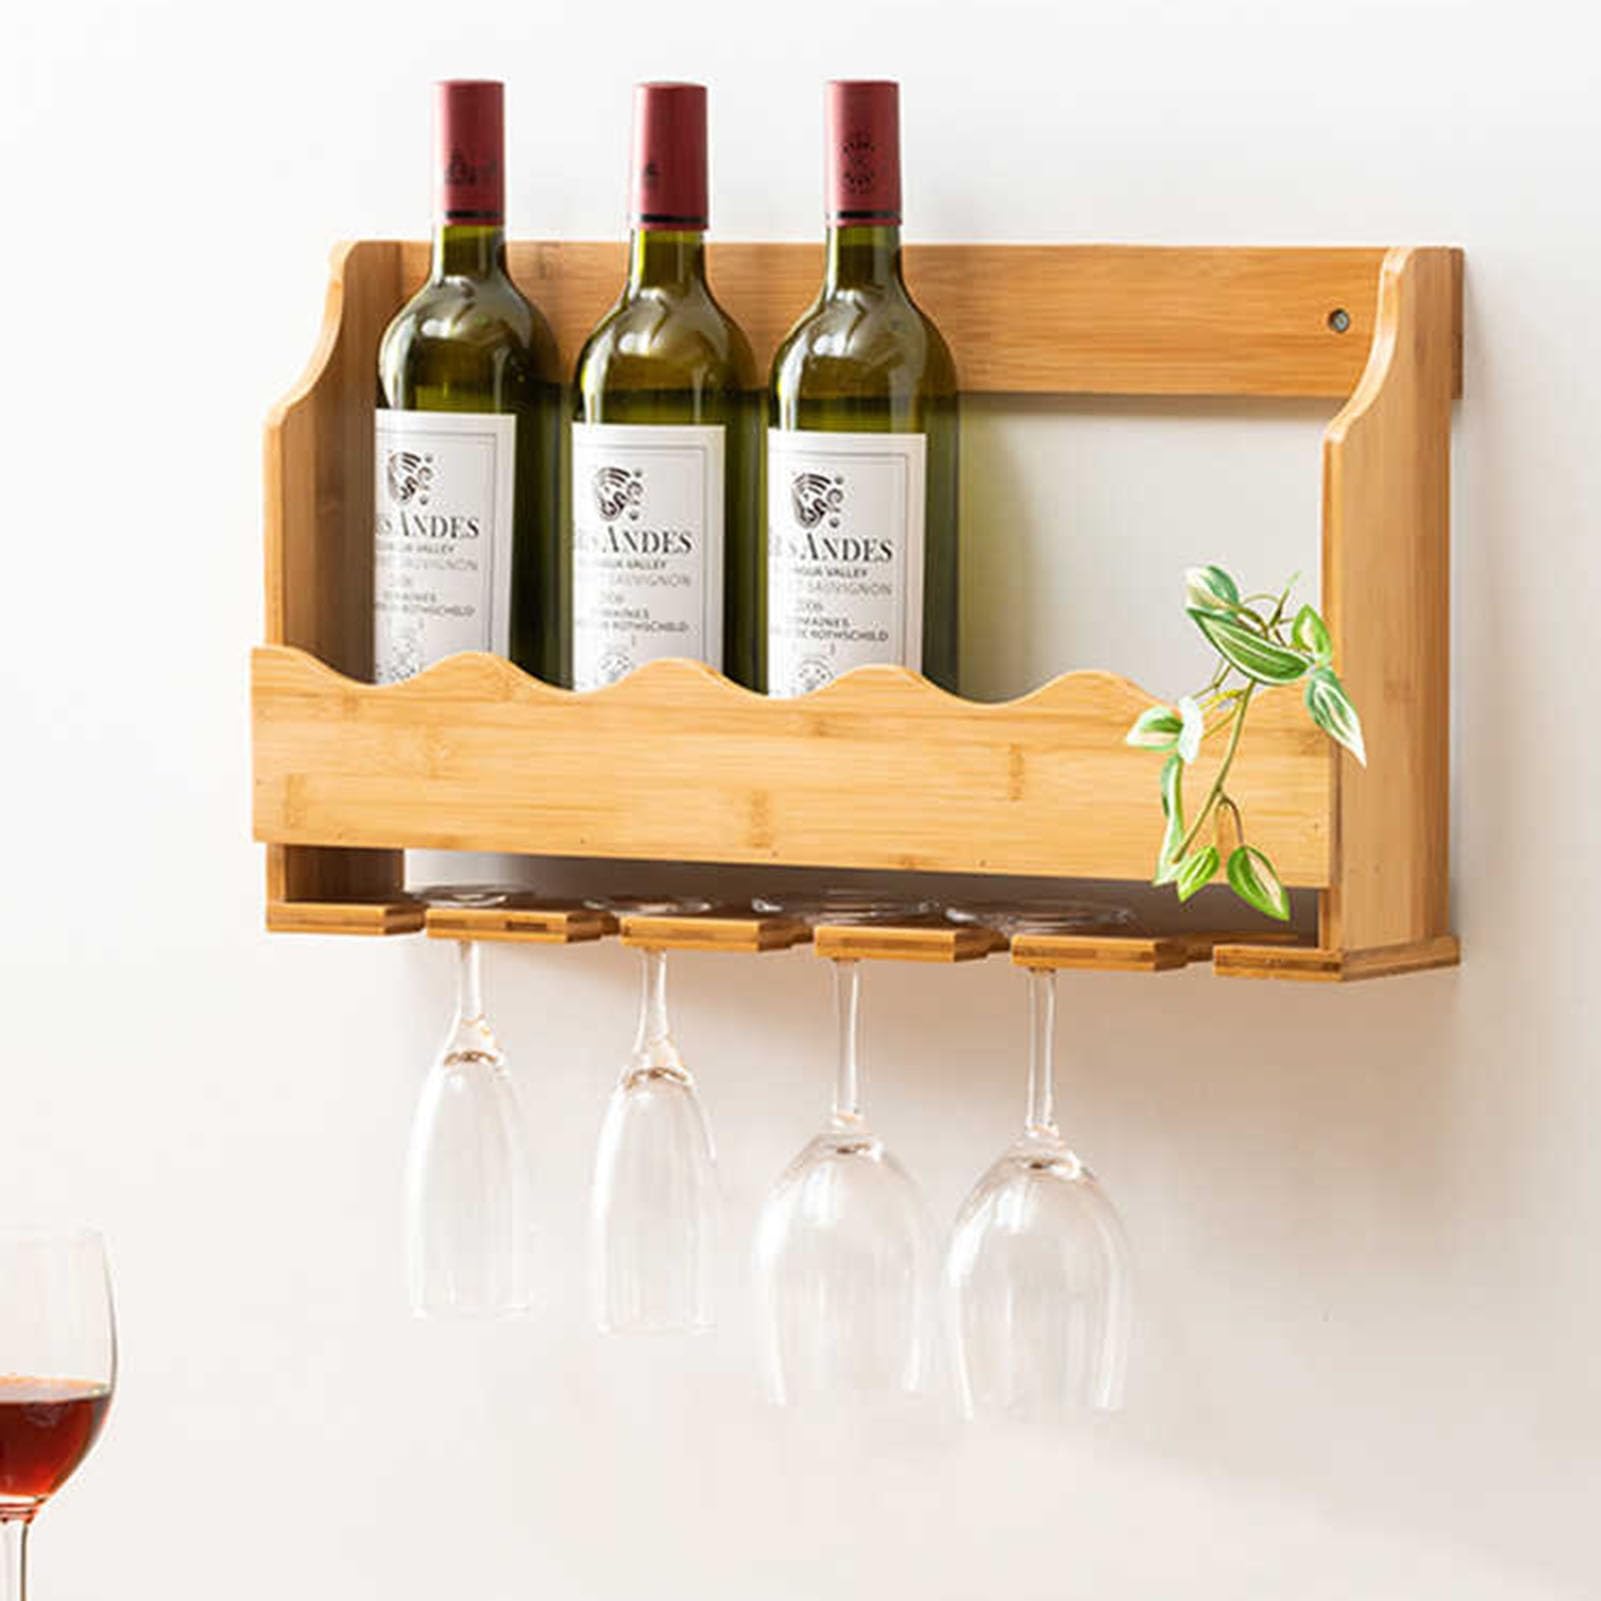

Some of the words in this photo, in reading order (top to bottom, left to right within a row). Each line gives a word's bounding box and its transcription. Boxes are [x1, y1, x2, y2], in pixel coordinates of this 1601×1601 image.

[399, 510, 480, 540] ANDES
[602, 525, 693, 555] ANDES
[800, 532, 893, 561] ANDES
[825, 565, 868, 577] VALLEY
